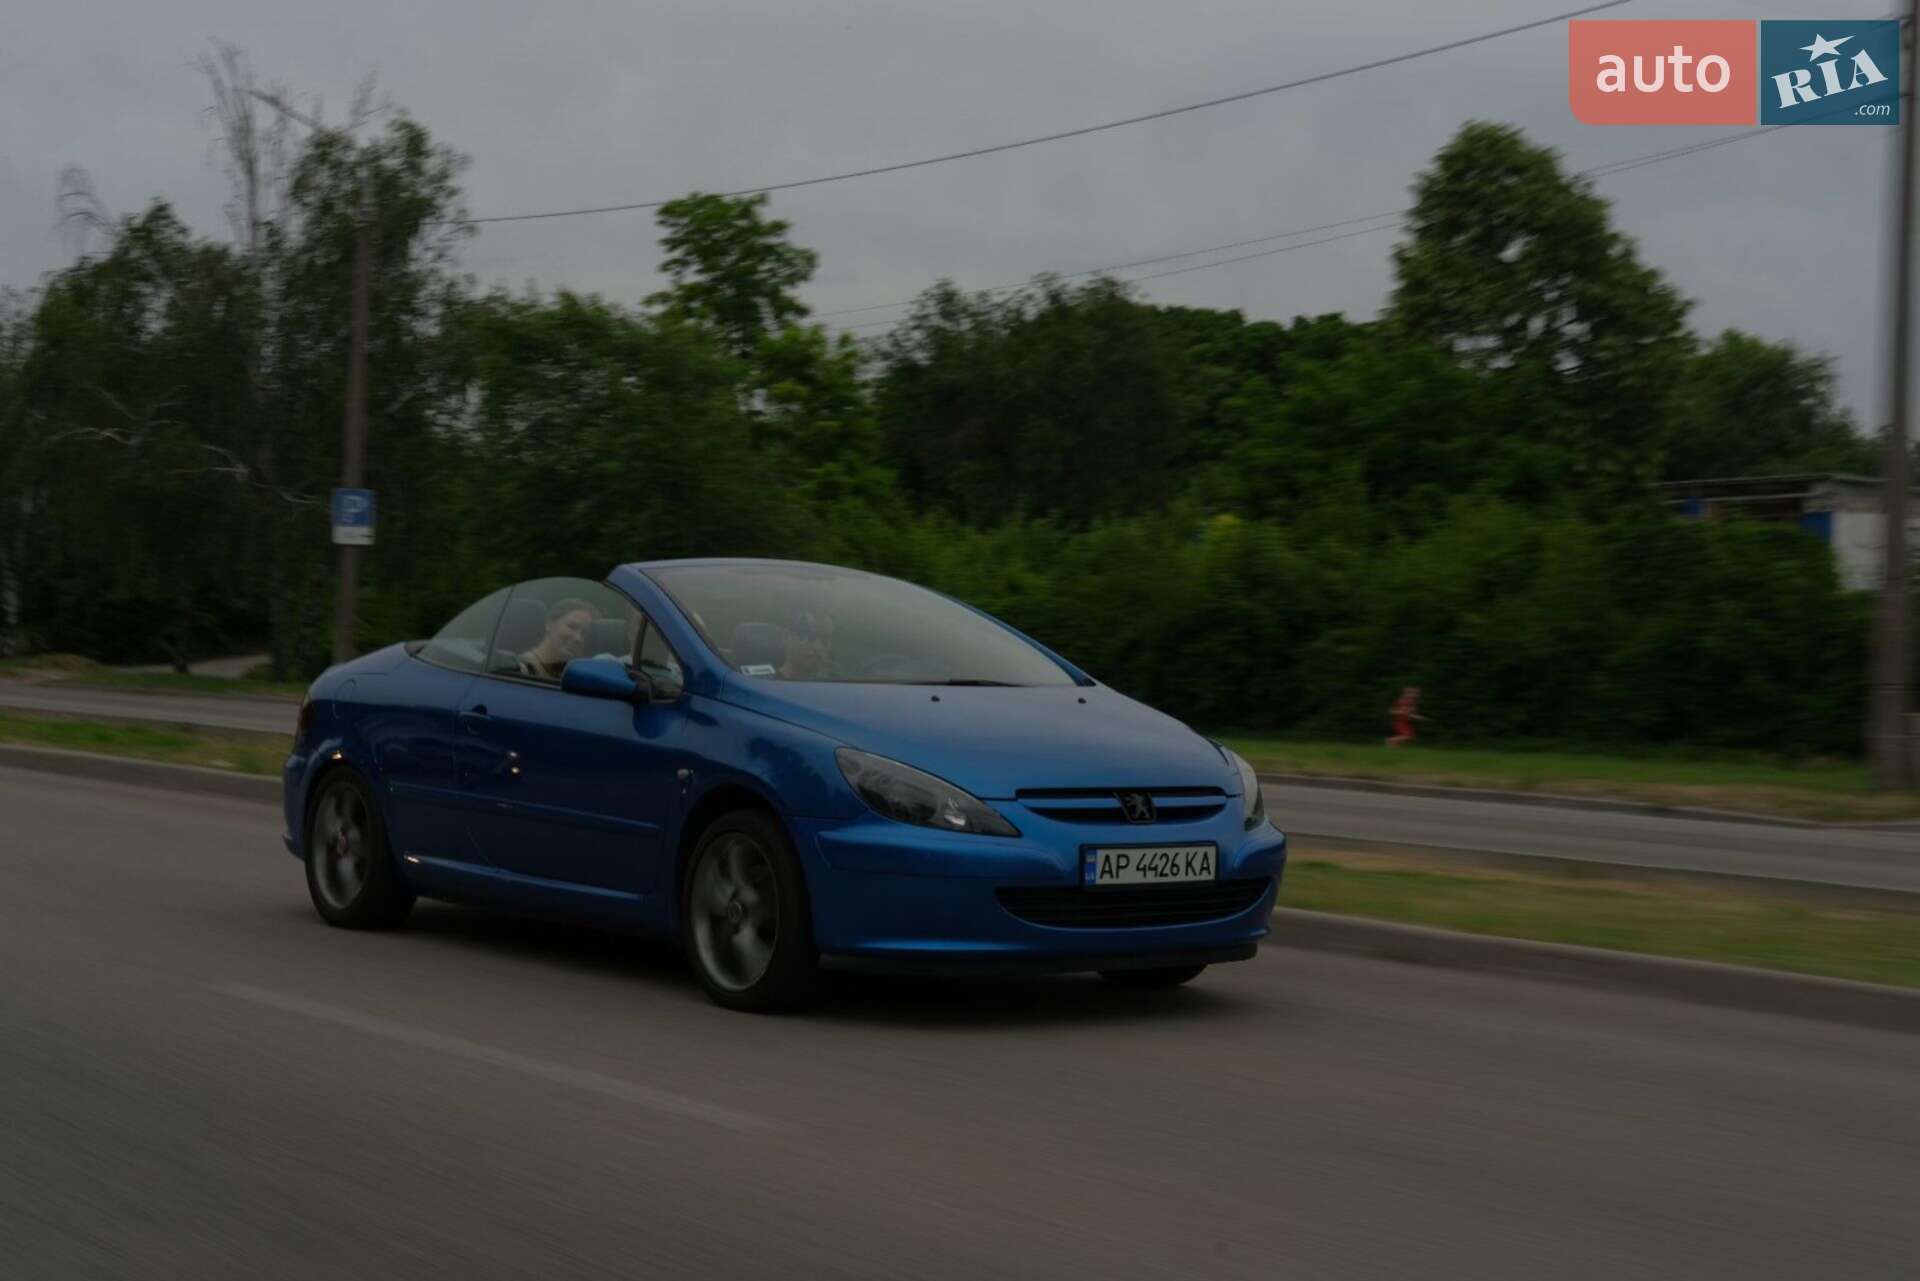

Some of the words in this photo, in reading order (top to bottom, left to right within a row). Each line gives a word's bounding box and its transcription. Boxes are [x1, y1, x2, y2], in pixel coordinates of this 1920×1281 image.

[1100, 853, 1130, 879] AP
[1136, 852, 1180, 878] 4426
[1185, 851, 1212, 877] KA
